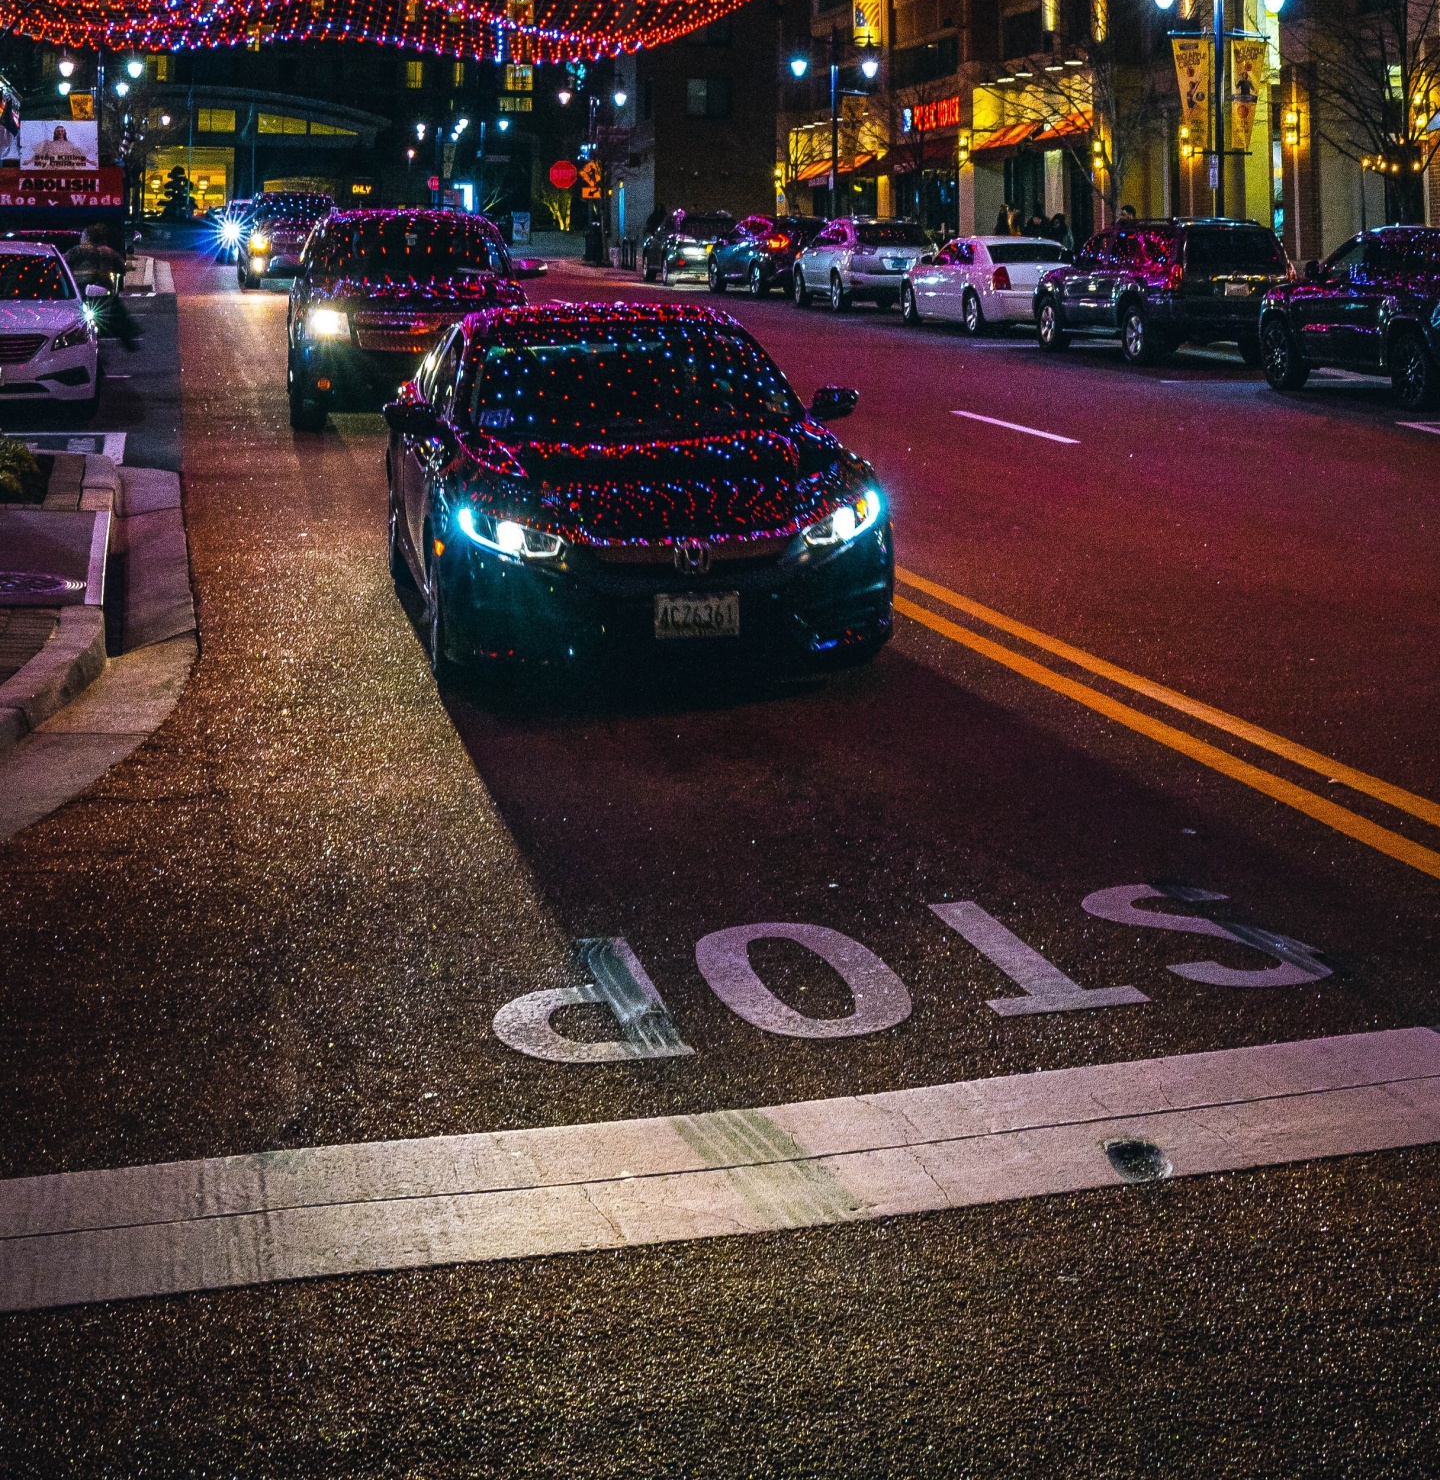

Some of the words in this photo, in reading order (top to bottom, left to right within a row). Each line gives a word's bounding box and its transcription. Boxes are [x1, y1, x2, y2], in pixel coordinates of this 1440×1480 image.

[552, 169, 574, 180] STOP
[21, 179, 96, 191] ABOLISH
[0, 194, 36, 205] Roe
[71, 194, 121, 206] Wade
[492, 884, 1334, 1064] STOP
